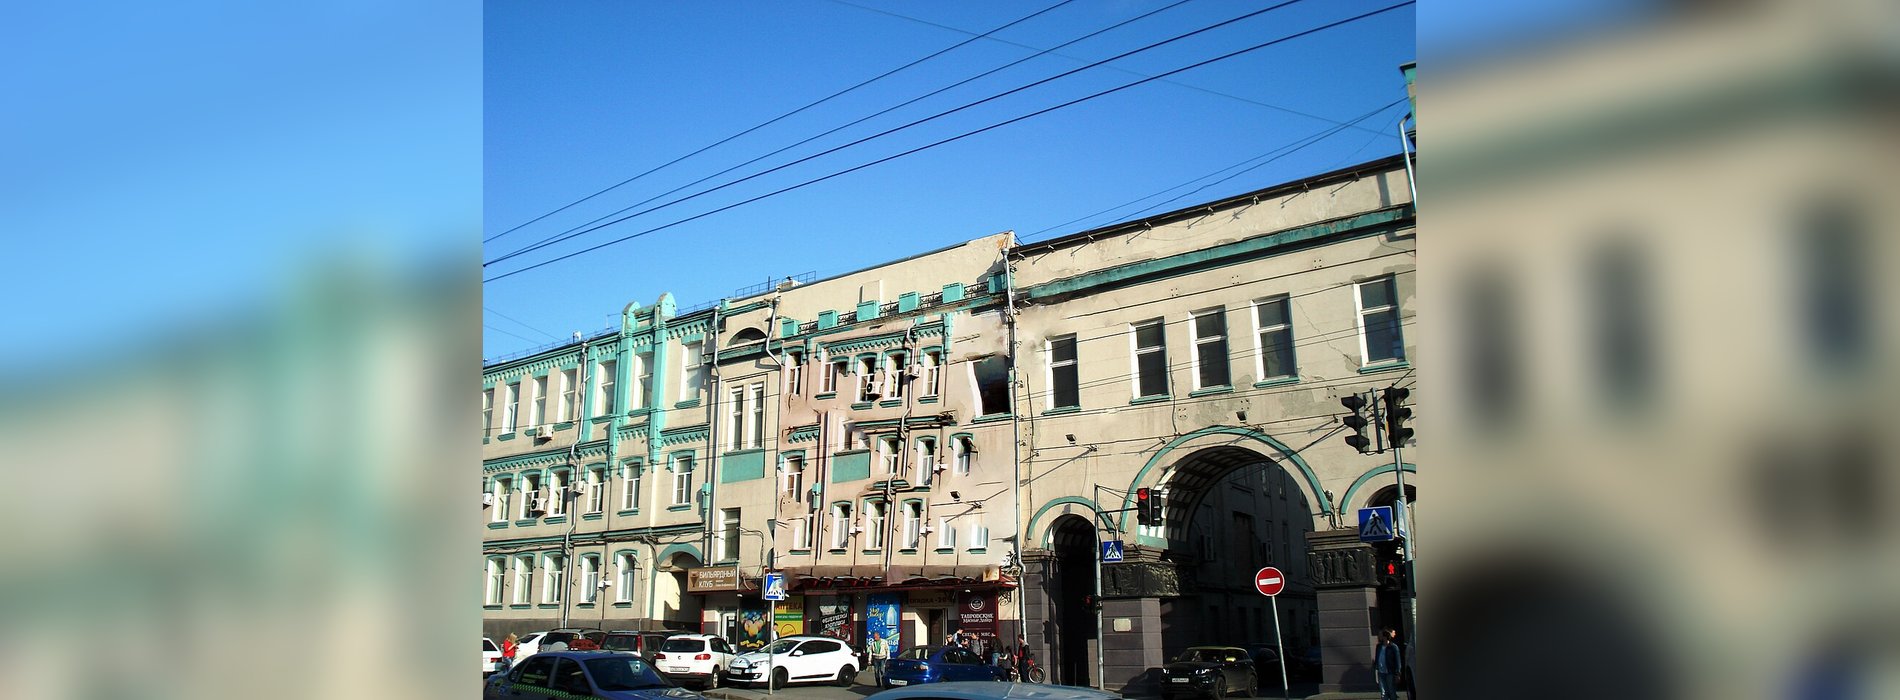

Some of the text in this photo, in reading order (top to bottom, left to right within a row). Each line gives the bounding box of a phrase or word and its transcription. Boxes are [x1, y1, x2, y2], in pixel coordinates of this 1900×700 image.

[699, 569, 736, 579] БИЛЬЯРДНЫЙ
[699, 580, 713, 588] КЛУБ
[775, 601, 803, 610] АПТЕКА
